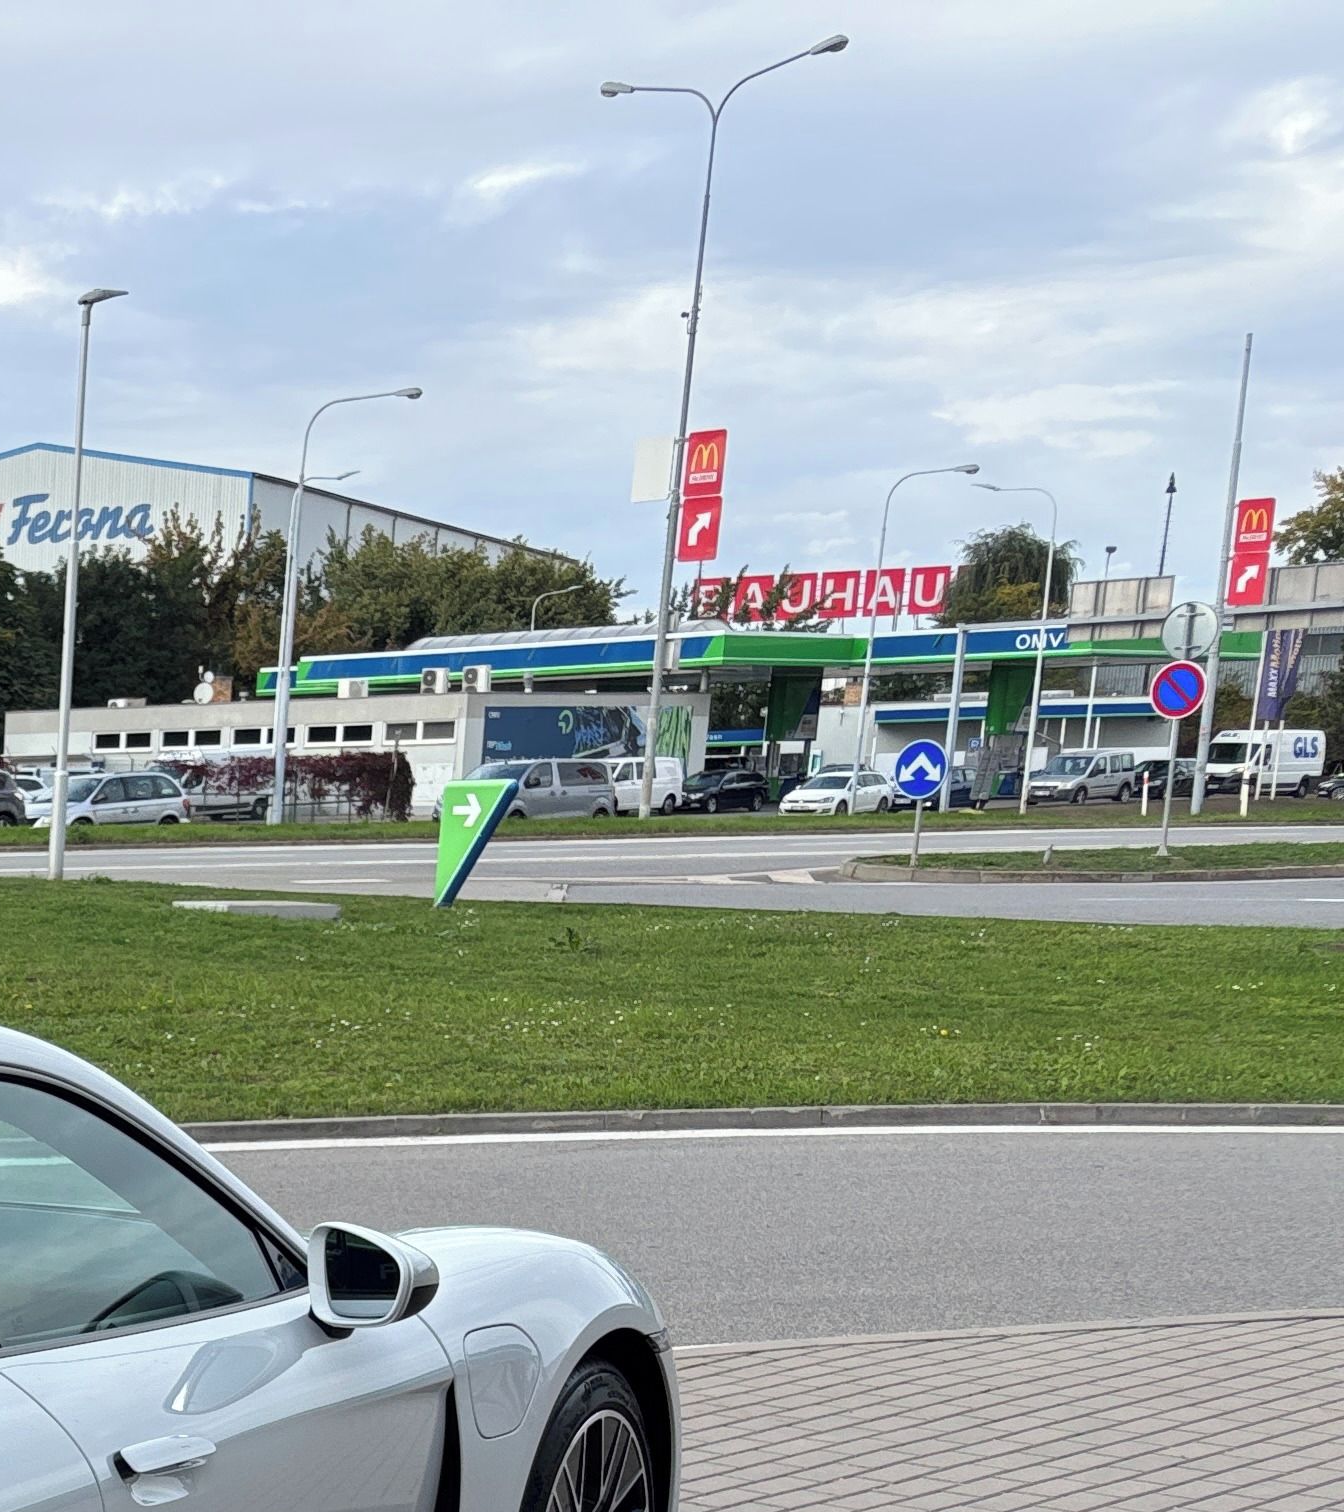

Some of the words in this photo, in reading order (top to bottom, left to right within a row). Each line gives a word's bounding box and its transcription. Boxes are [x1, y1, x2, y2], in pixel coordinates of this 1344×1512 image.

[7, 492, 154, 546] Ferona
[697, 572, 949, 618] BAUHAU
[1015, 632, 1065, 650] OMV
[1293, 736, 1319, 759] GLS
